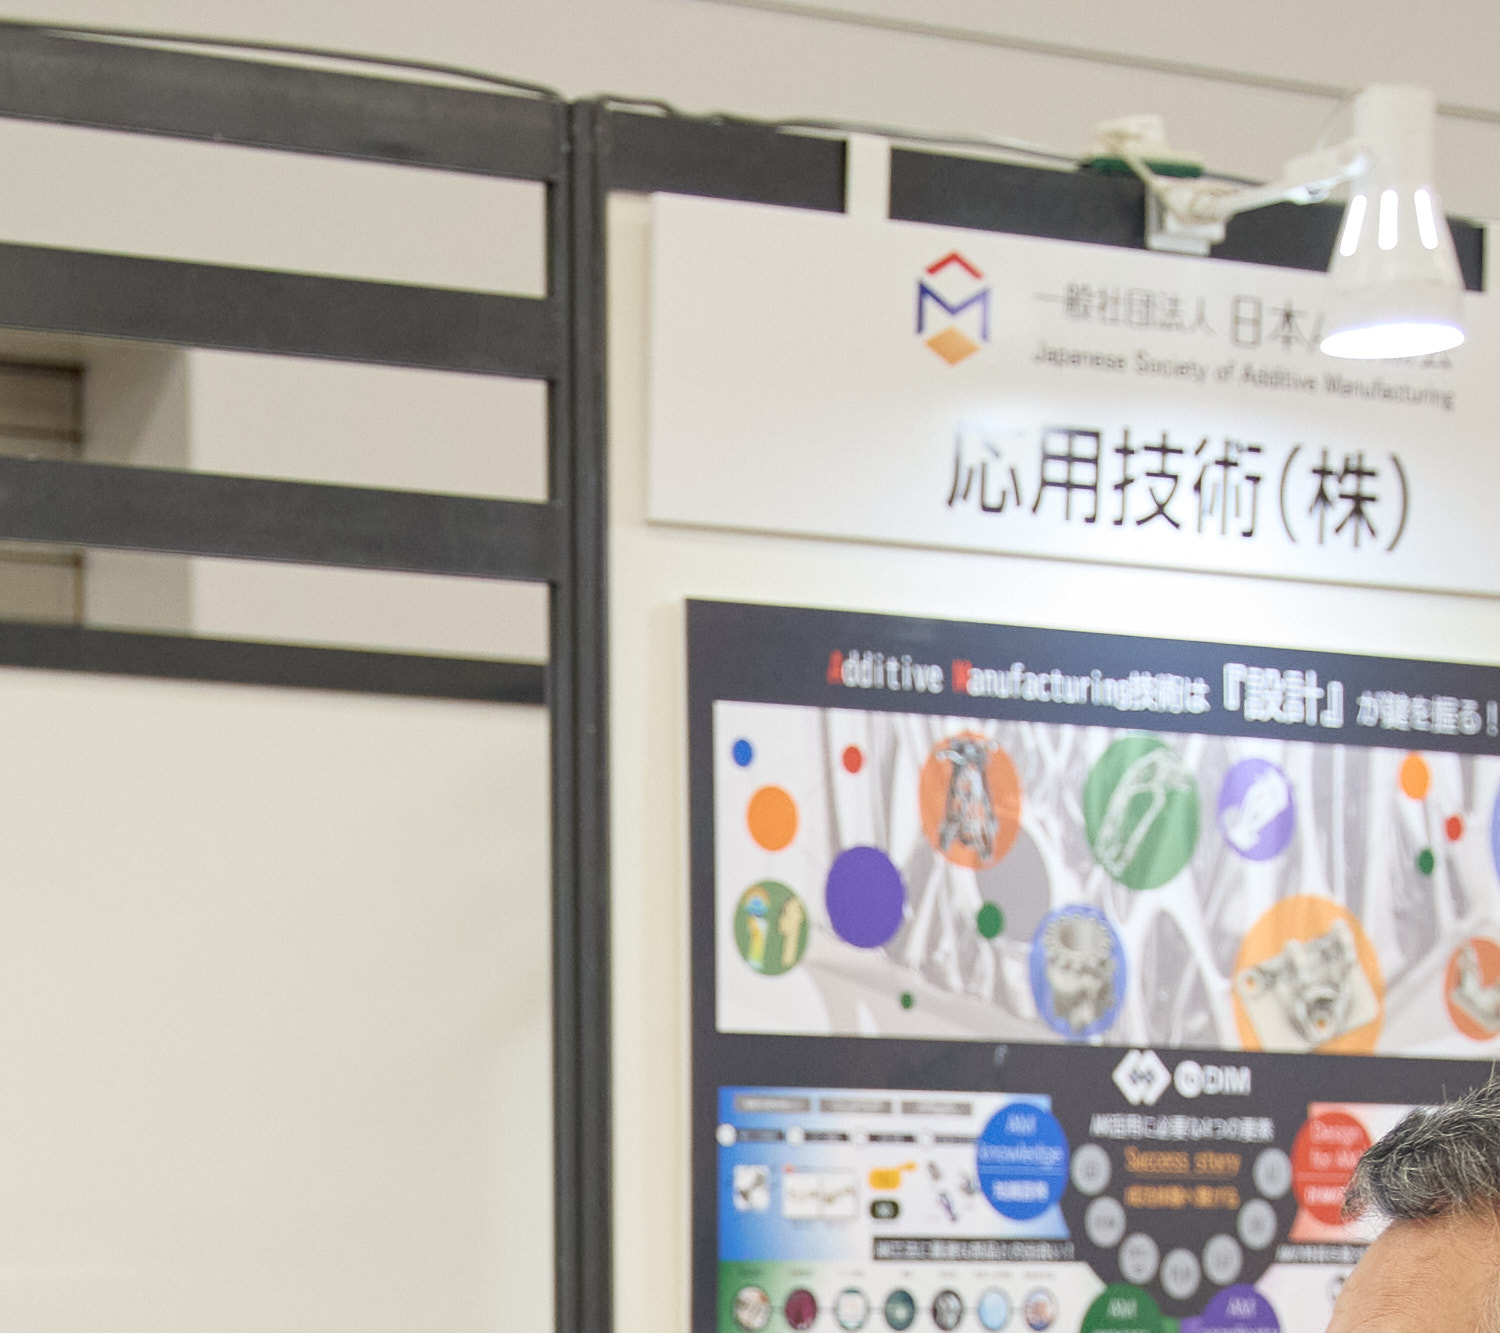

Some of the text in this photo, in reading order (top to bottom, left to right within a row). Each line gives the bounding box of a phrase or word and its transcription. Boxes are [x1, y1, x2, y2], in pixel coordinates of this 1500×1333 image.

[1032, 340, 1456, 413] Japanese Society of Additive Manufacturing
[947, 417, 1410, 552] 応用技術(株)
[826, 649, 945, 695] Additive
